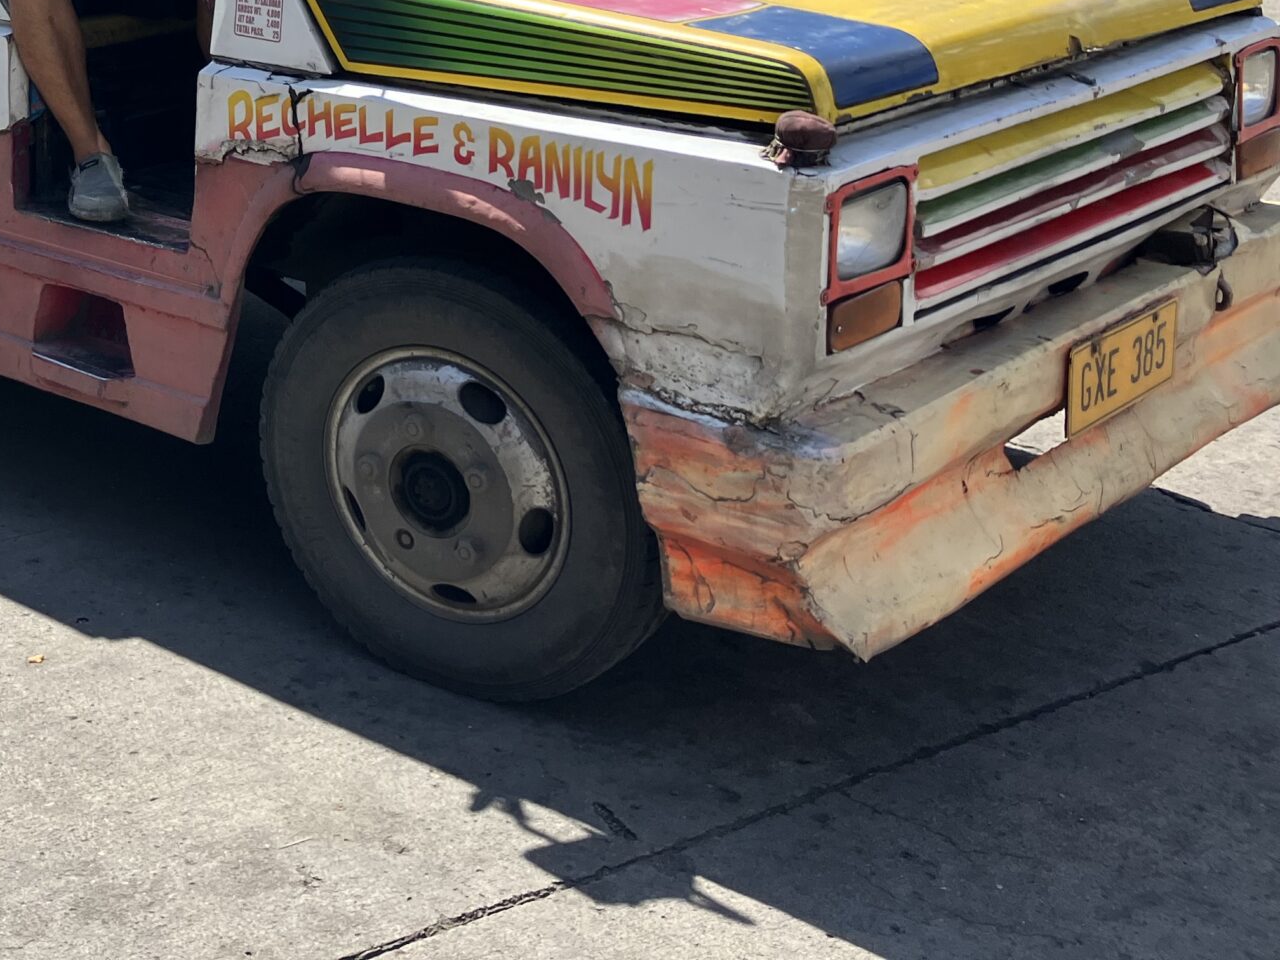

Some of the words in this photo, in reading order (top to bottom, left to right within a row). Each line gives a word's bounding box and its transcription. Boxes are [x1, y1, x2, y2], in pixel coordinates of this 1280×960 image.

[272, 30, 280, 40] 25
[227, 89, 440, 157] RECHELLE
[452, 120, 476, 166] &
[487, 125, 656, 233] RANILYN
[1080, 347, 1120, 412] GXE
[1130, 320, 1168, 384] 385
